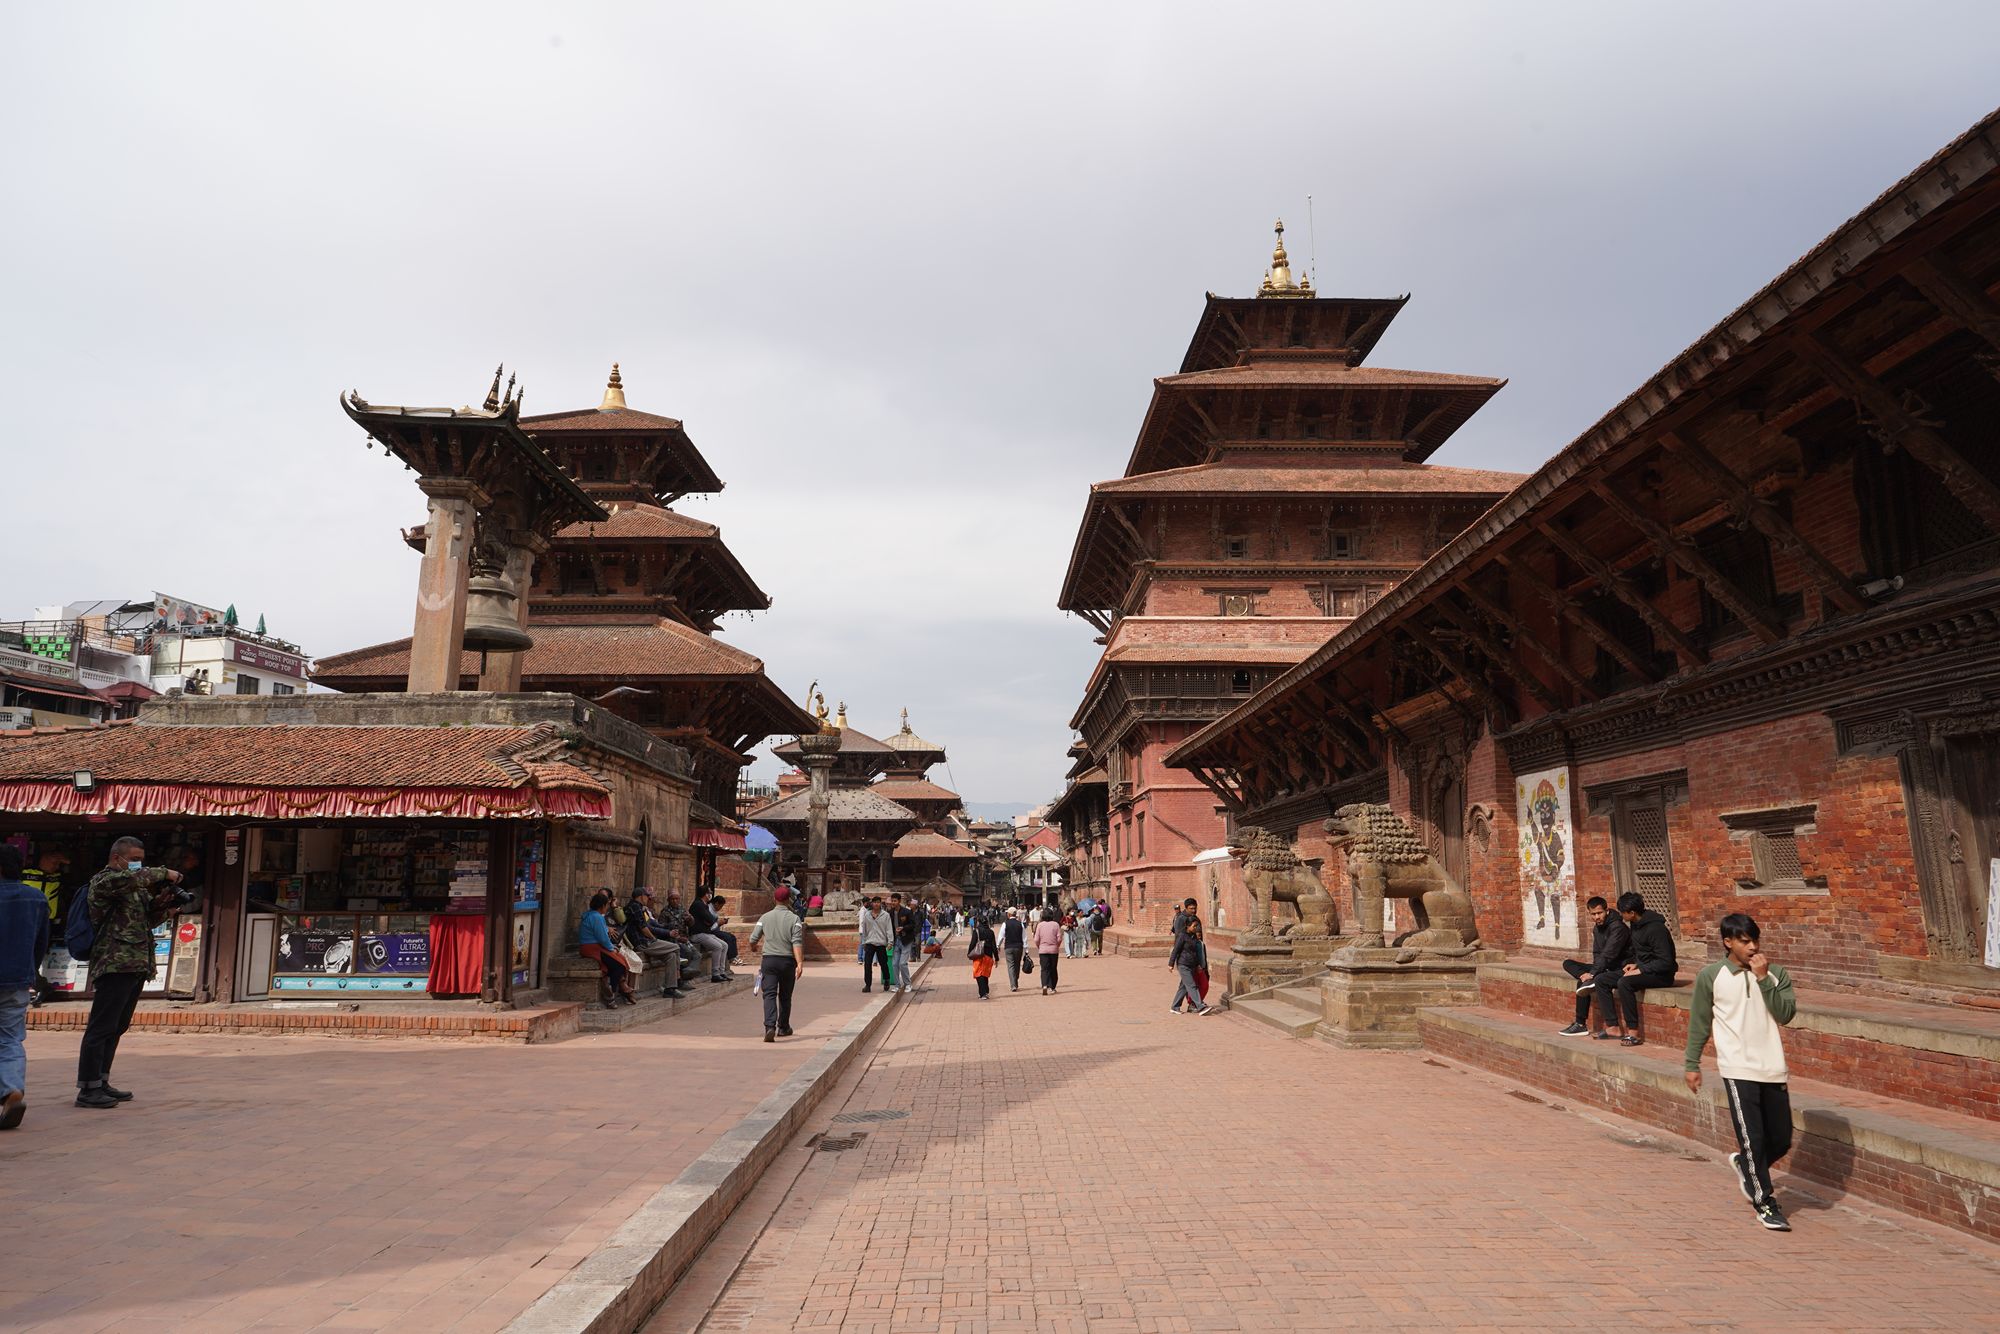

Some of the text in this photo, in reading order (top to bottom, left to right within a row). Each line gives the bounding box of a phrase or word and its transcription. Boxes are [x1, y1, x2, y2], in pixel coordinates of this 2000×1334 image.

[258, 650, 282, 662] HIGHEST
[283, 658, 298, 666] POINT
[264, 660, 280, 670] ROOF
[305, 943, 325, 951] PRO
[400, 943, 427, 951] ULTRA2
